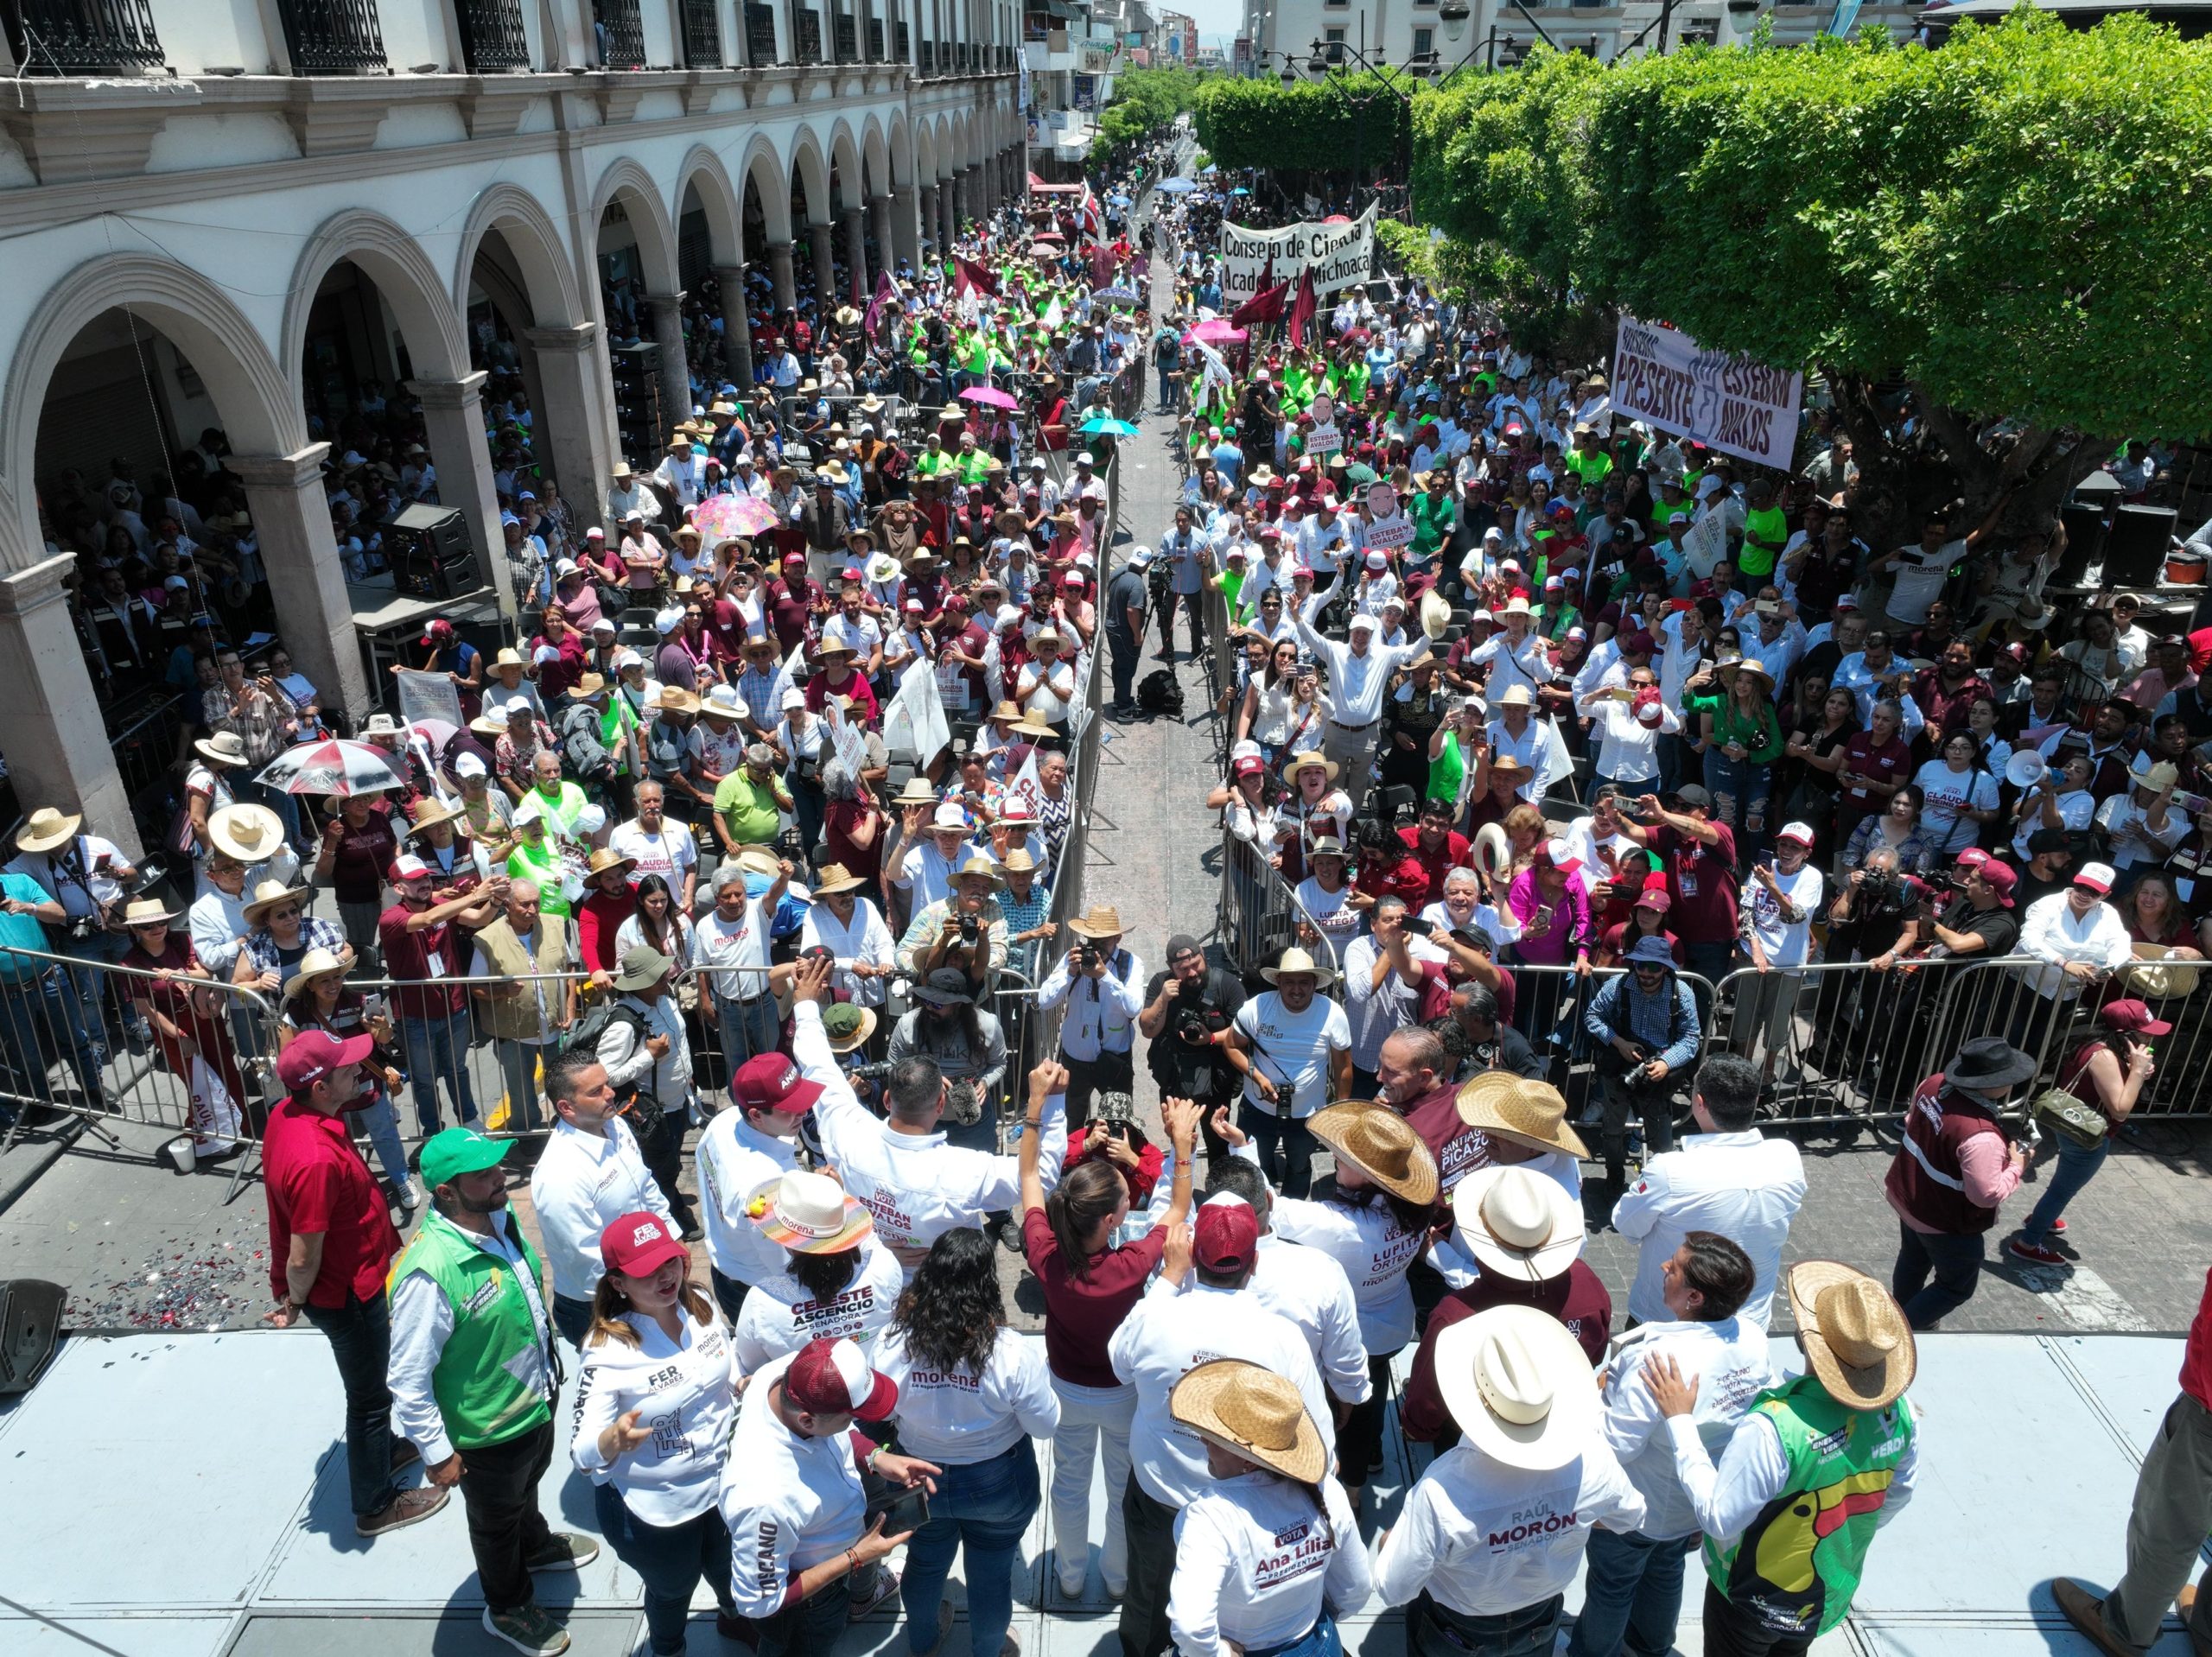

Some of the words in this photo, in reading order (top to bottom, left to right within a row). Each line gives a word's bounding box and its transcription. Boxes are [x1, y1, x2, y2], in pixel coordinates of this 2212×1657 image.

[1224, 231, 1281, 260] Consejo
[1286, 233, 1305, 259] de
[1311, 246, 1372, 285] Michoacá
[1615, 352, 1697, 429] PRESENTE
[1722, 354, 1793, 409] ESTEBAN
[1714, 398, 1773, 456] AVALOS
[1309, 433, 1338, 443] ESTEBAN
[1310, 440, 1334, 448] AVALOS
[1369, 524, 1409, 541] ESTEBAN
[1370, 533, 1405, 547] AVALOS
[1925, 797, 1955, 808] SHEINB
[1926, 791, 1963, 804] CLAUD
[715, 928, 749, 946] morena
[193, 1095, 213, 1128] RAÚL
[1441, 1127, 1486, 1158] SANTIAG
[598, 1168, 619, 1190] morena
[1442, 1169, 1465, 1188] JUNTOS
[859, 1196, 912, 1223] ESTEBAN
[874, 1191, 896, 1208] VOTA
[633, 1222, 655, 1237] FER
[780, 1216, 816, 1236] morena
[871, 1209, 913, 1230] VALOS
[873, 1226, 908, 1244] orena
[1373, 1236, 1421, 1263] LUPITA
[474, 1284, 499, 1311] VERDE
[791, 1285, 874, 1316] CEESTE
[792, 1298, 874, 1328] ASCENCIO
[809, 1313, 858, 1330] SENADORA
[696, 1331, 720, 1353] morena
[648, 1365, 679, 1387] FER
[649, 1373, 685, 1394] ALVAREZ
[912, 1371, 980, 1388] morena
[1724, 1381, 1742, 1391] VOTA
[651, 1410, 683, 1459] FER
[1173, 1429, 1199, 1441] MICHO
[1512, 1501, 1556, 1524] RAÚL
[1288, 1518, 1307, 1531] JUNIO
[1489, 1512, 1577, 1546] MORÓN
[1280, 1531, 1304, 1546] VOTA
[1508, 1532, 1560, 1552] SENADOR
[758, 1521, 779, 1599] TOSCANO
[1255, 1557, 1290, 1576] Ana
[1268, 1556, 1318, 1580] PRESIDENTA
